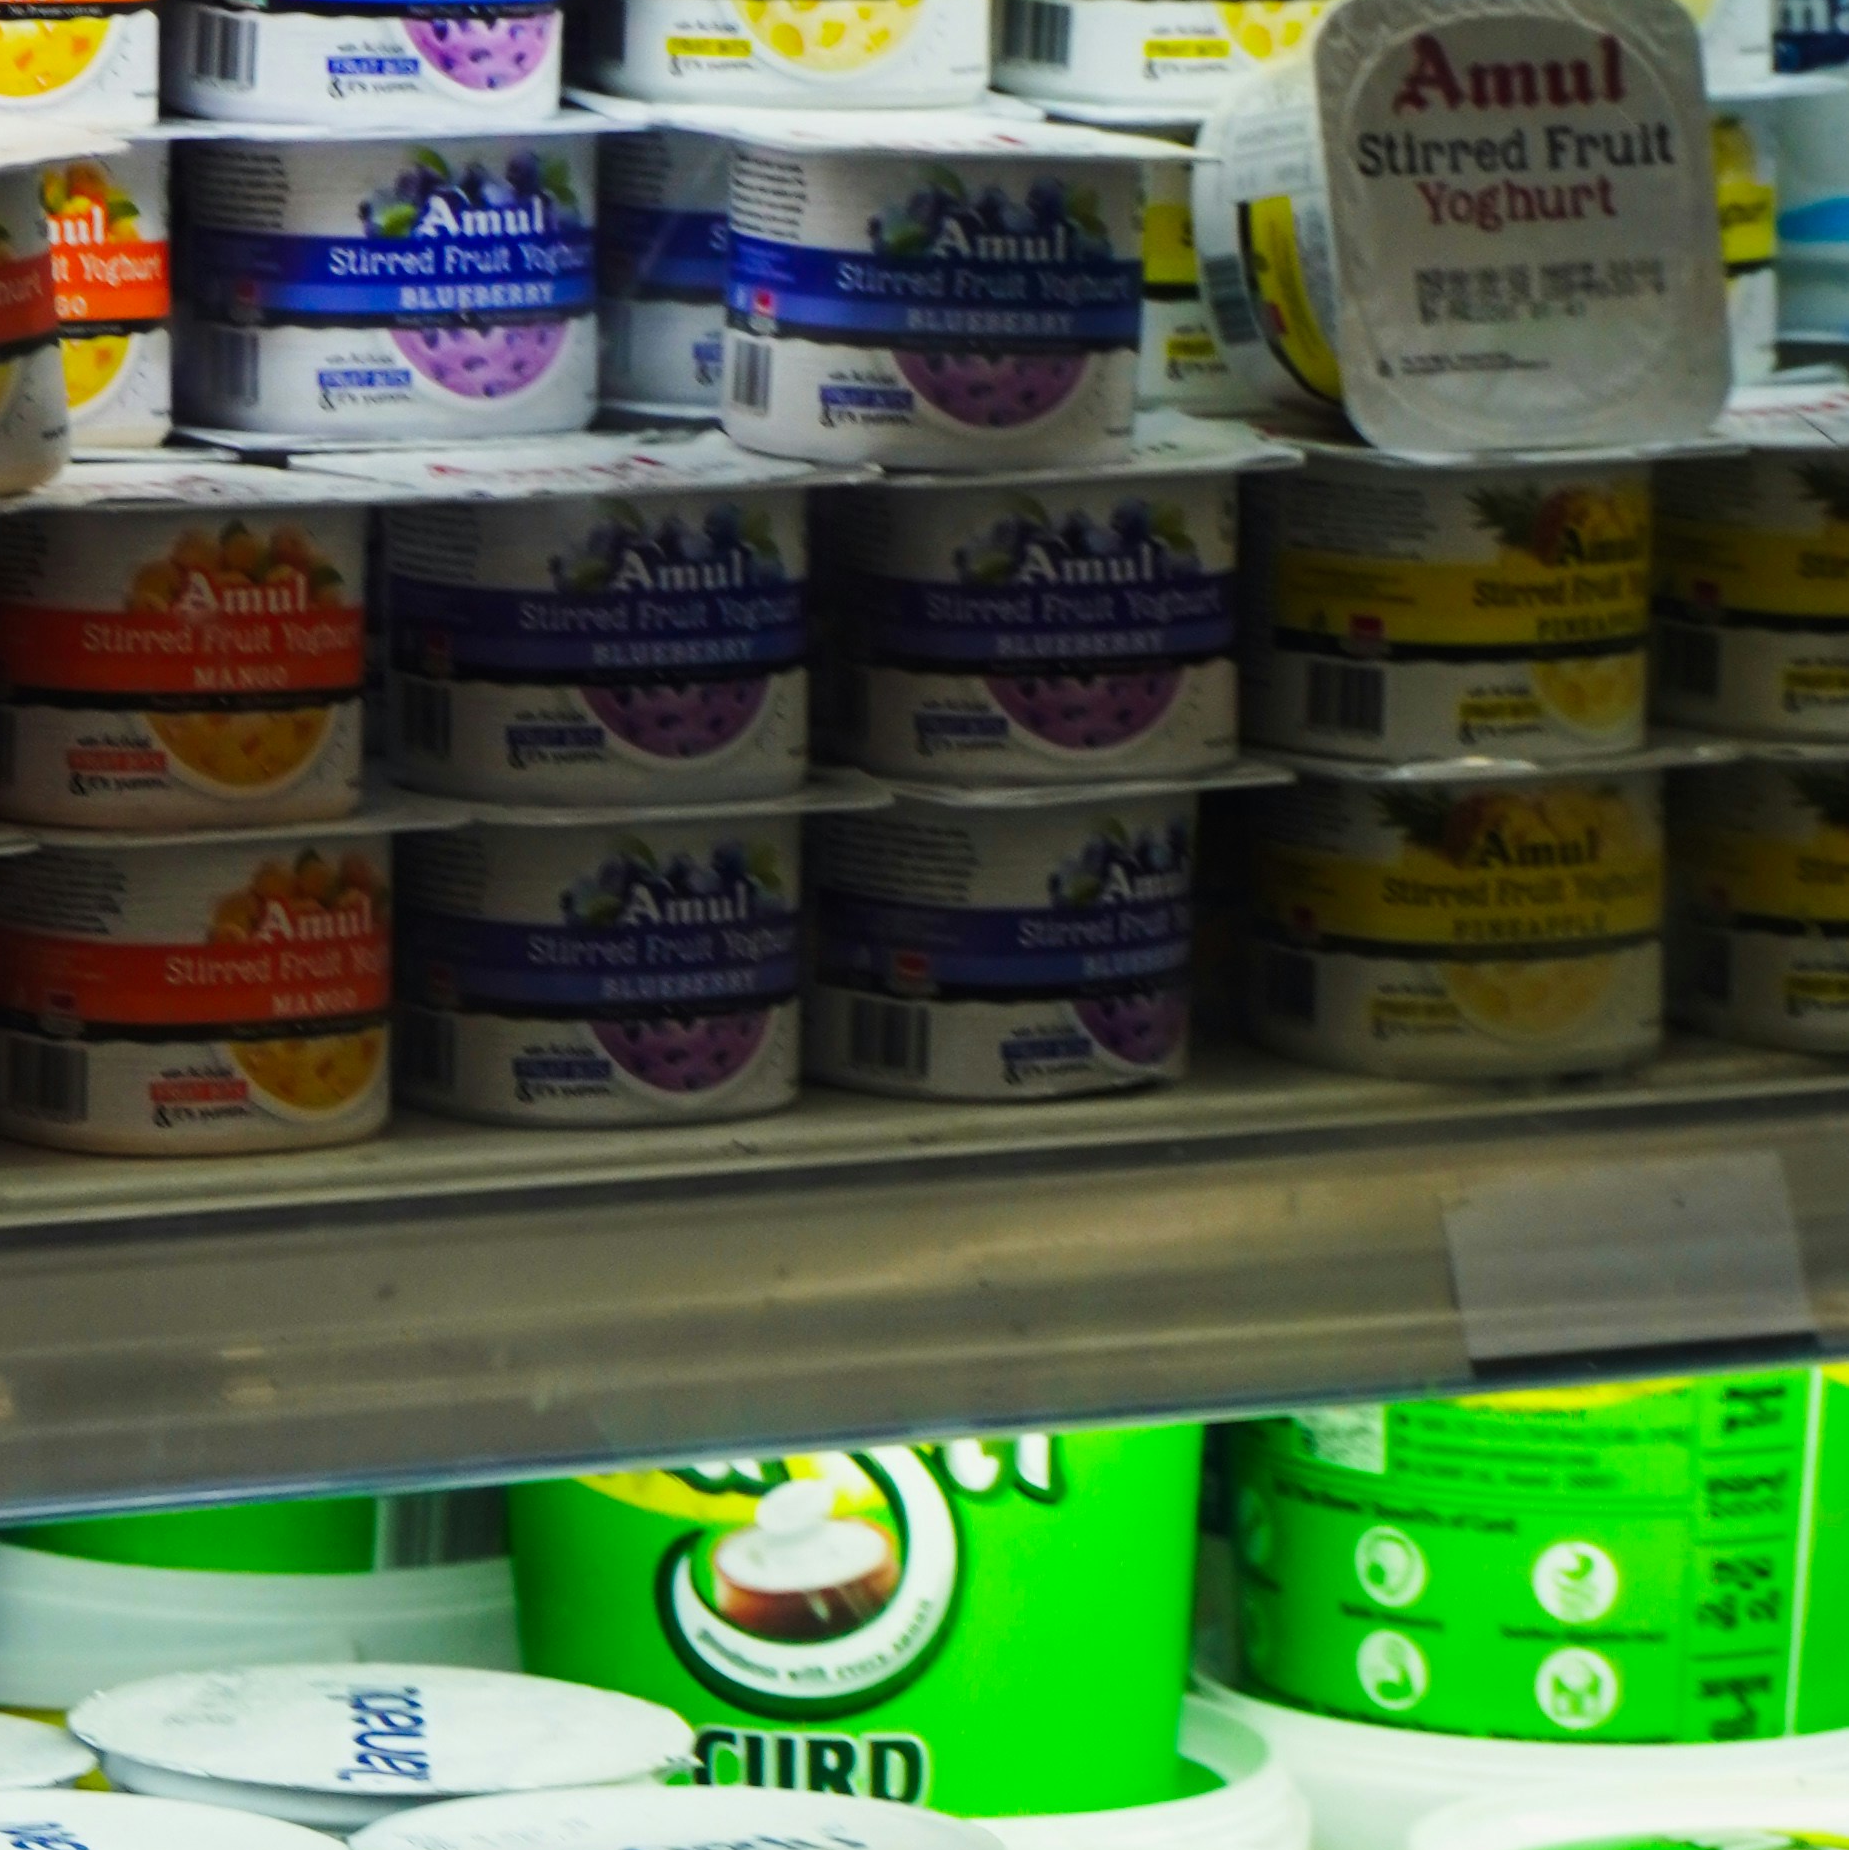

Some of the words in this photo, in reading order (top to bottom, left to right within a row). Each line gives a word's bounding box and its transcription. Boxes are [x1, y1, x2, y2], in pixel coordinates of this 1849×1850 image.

[1393, 31, 1630, 116] Amul
[1357, 129, 1534, 180] Stirred
[1544, 122, 1676, 169] Fruit
[416, 193, 547, 239] Amul
[1415, 177, 1621, 234] Yoghurt
[327, 246, 436, 277] Stirred
[444, 248, 514, 277] Fruit
[935, 213, 1068, 262] Amul
[181, 569, 309, 616] Amul
[272, 991, 357, 1016] MANGO
[694, 1729, 928, 1803] CURD
